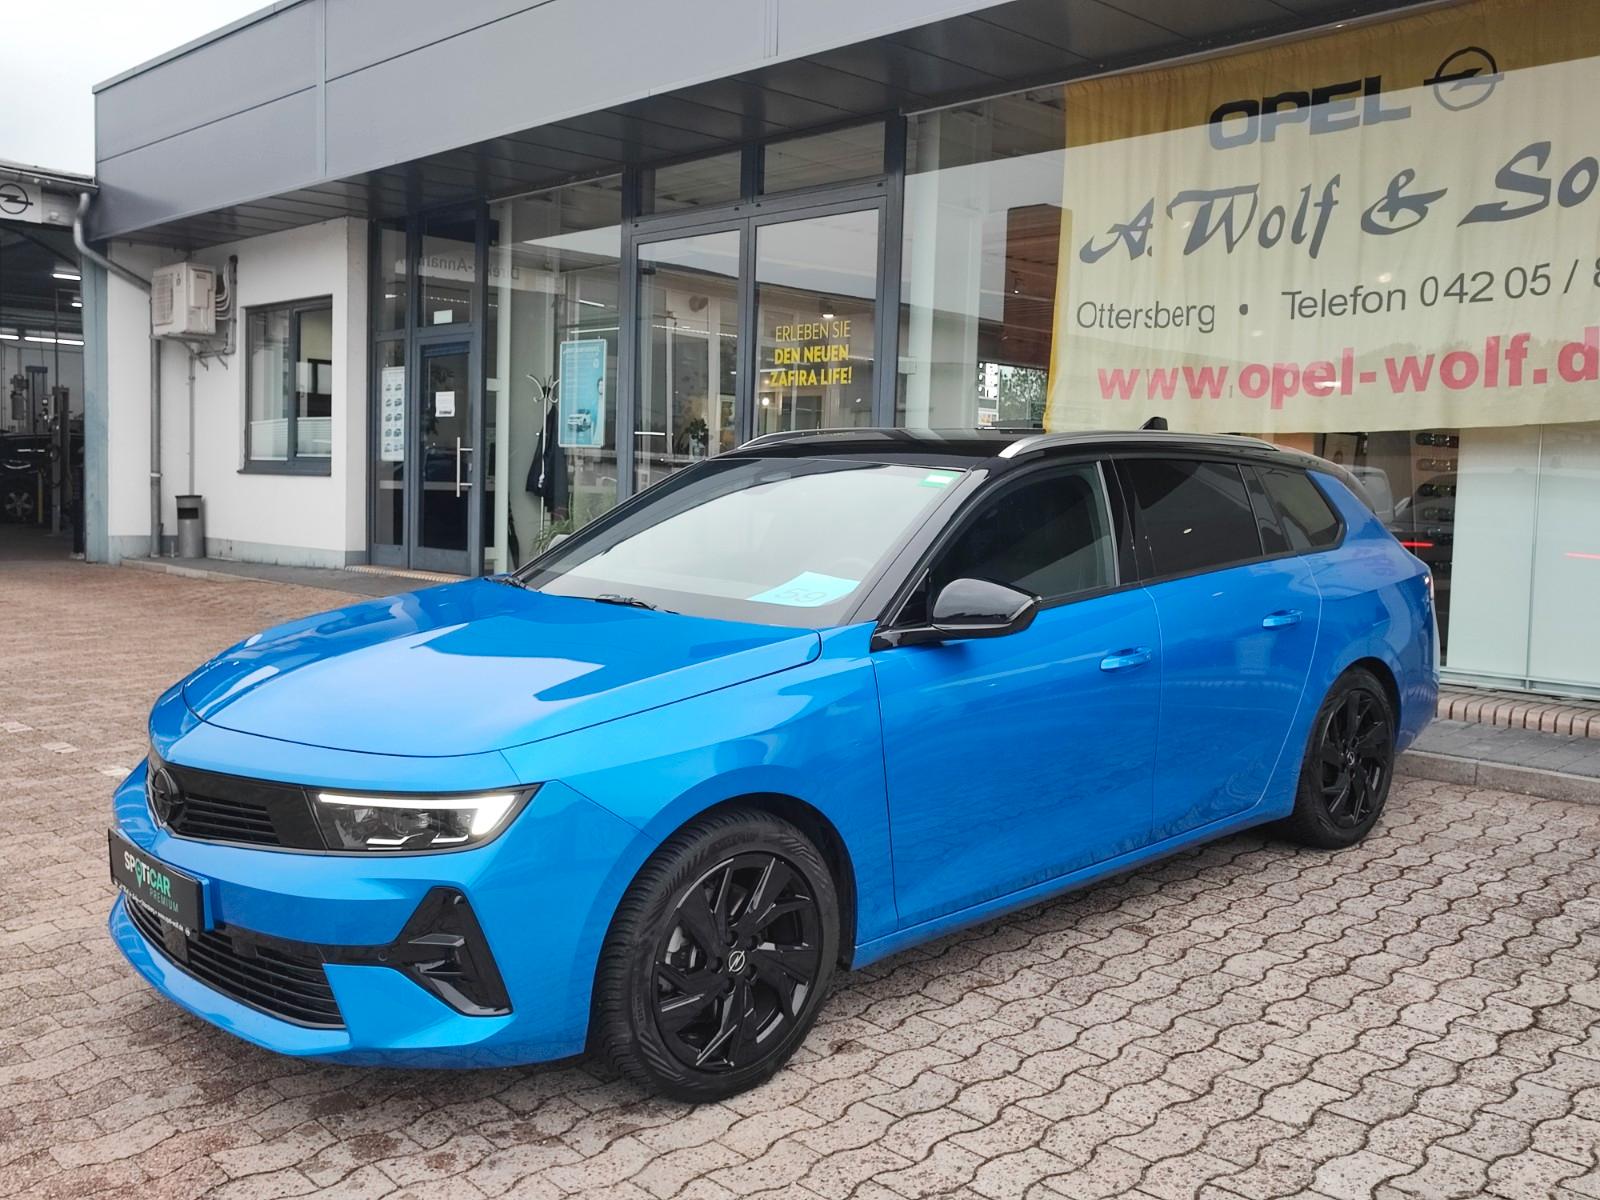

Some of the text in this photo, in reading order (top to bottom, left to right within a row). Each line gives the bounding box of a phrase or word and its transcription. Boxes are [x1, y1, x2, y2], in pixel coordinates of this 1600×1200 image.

[1209, 76, 1411, 150] OPEL
[1360, 168, 1448, 235] &
[1457, 141, 1600, 228] So
[1077, 301, 1215, 333] Ottersberg
[1281, 285, 1406, 320] Telefon
[775, 320, 851, 342] ERLEBEN SIE
[774, 344, 849, 365] DEN NEUEN
[1097, 326, 1600, 410] wwwopel-wolf.d
[769, 366, 852, 387] ZAFIRA LIFE!
[150, 888, 179, 913] PREMIUM
